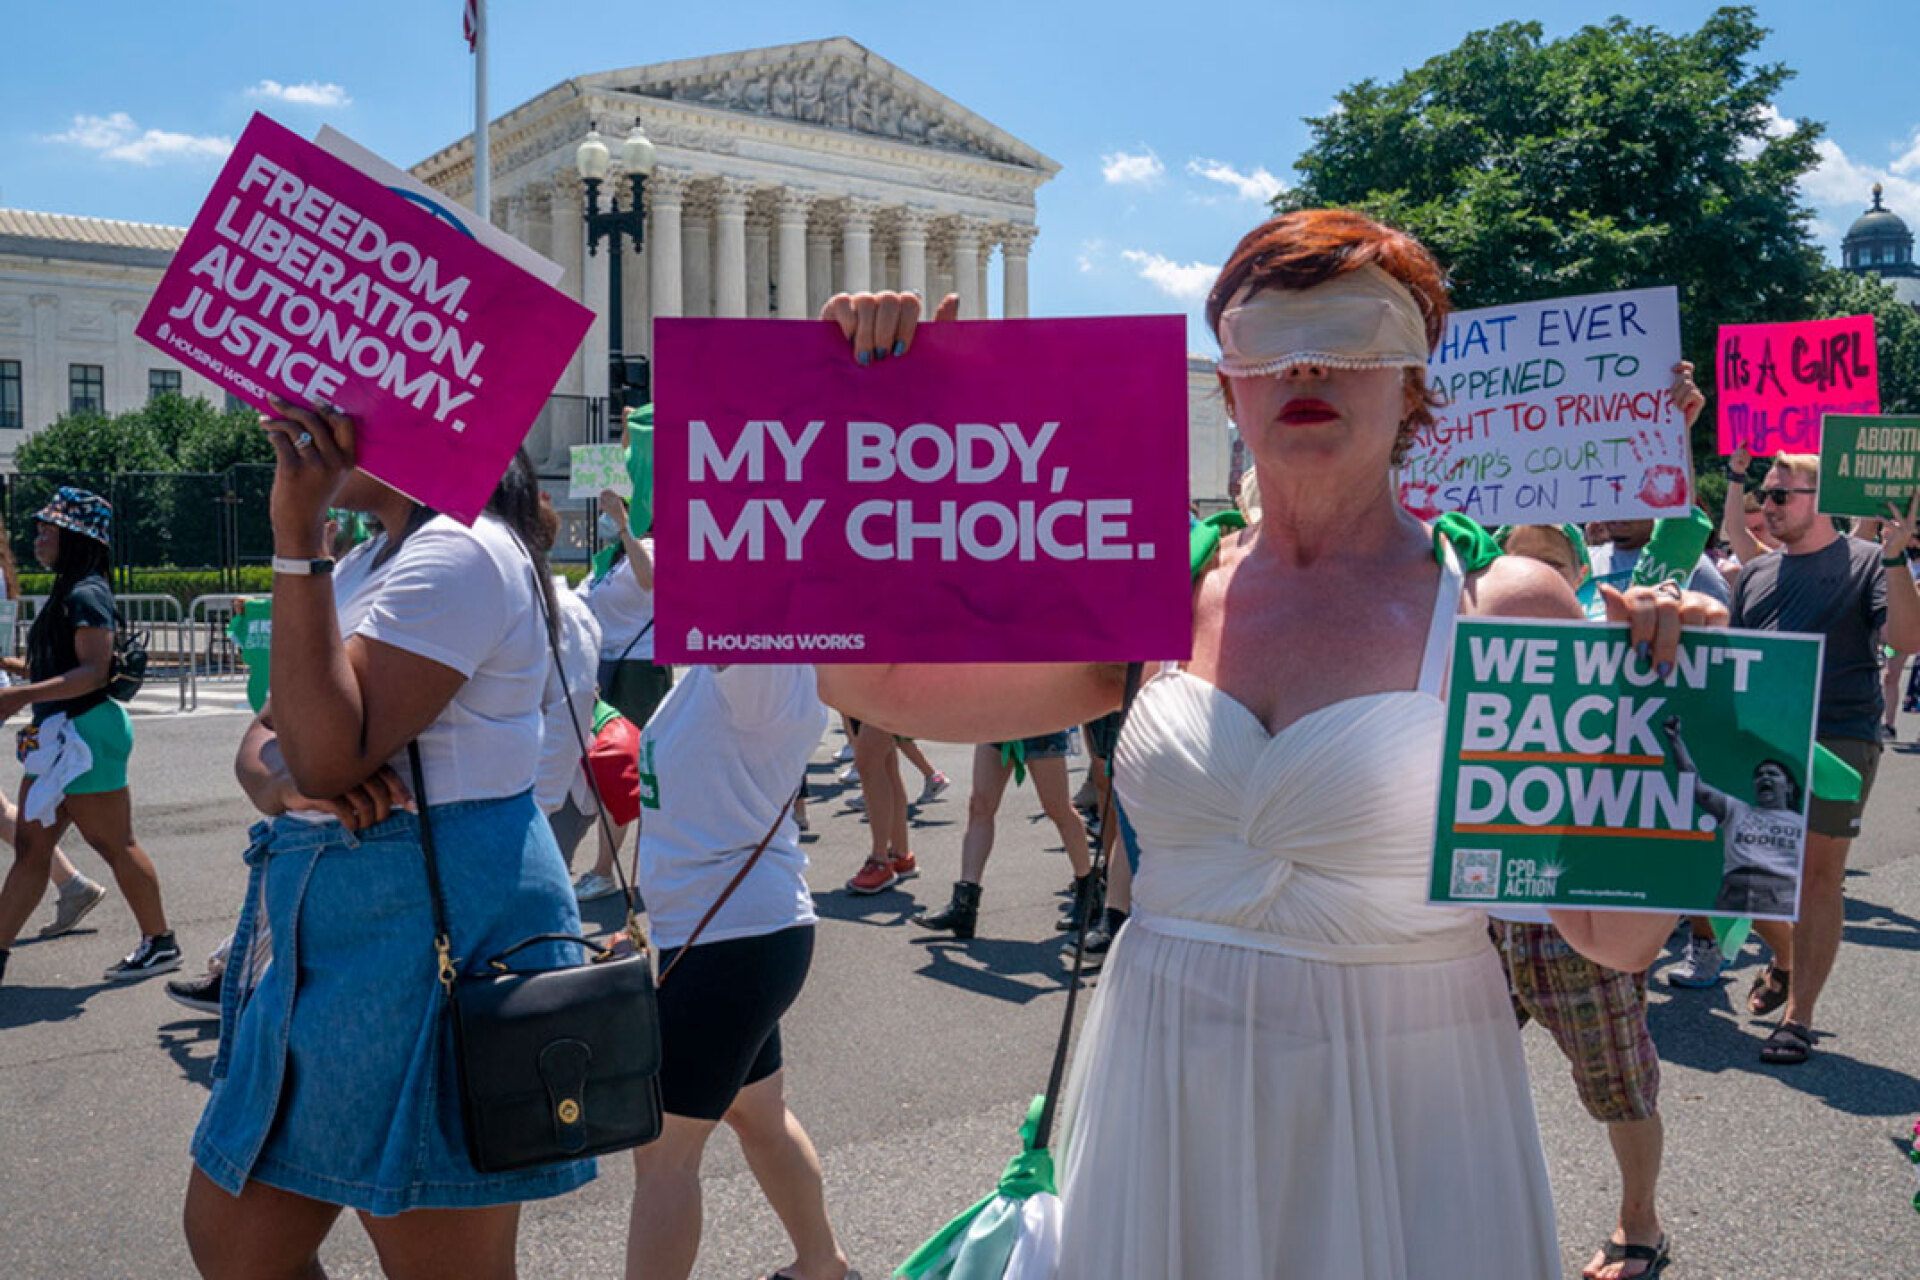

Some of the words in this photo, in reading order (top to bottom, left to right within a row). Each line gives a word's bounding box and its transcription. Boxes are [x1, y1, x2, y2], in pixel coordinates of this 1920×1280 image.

[238, 153, 470, 322] FREEDOM.
[214, 196, 484, 387] LIBERATION.
[189, 244, 474, 432] AUTONOMY.
[1427, 315, 1517, 365] HAT
[1538, 302, 1647, 347] EVER
[1756, 338, 1787, 396] A
[1791, 332, 1870, 392] GIRL
[168, 333, 223, 373] HOUSING
[222, 365, 267, 399] WORKS
[1431, 358, 1566, 402] APPENED
[1585, 354, 1640, 383] TO
[1504, 402, 1547, 432] TO
[1555, 389, 1673, 428] PRIVACY?
[1855, 426, 1920, 452] ABORTI
[688, 420, 825, 482] MY
[847, 421, 1069, 494] BODY,
[1524, 437, 1630, 474] COURT
[1838, 453, 1849, 477] A
[1855, 453, 1915, 479] HUMAN
[1444, 484, 1504, 515] SAT
[1516, 478, 1557, 509] ON
[1580, 475, 1626, 508] IT
[688, 499, 826, 562] MY
[845, 499, 1155, 562] CHOICE.
[707, 634, 794, 650] HOUSING
[797, 634, 865, 650] WORKS
[1468, 636, 1558, 685] WE
[1573, 639, 1763, 692] WON'T
[1461, 692, 1667, 757] BACK
[1454, 764, 1717, 832] DOWN.
[1504, 878, 1557, 897] ACTION
